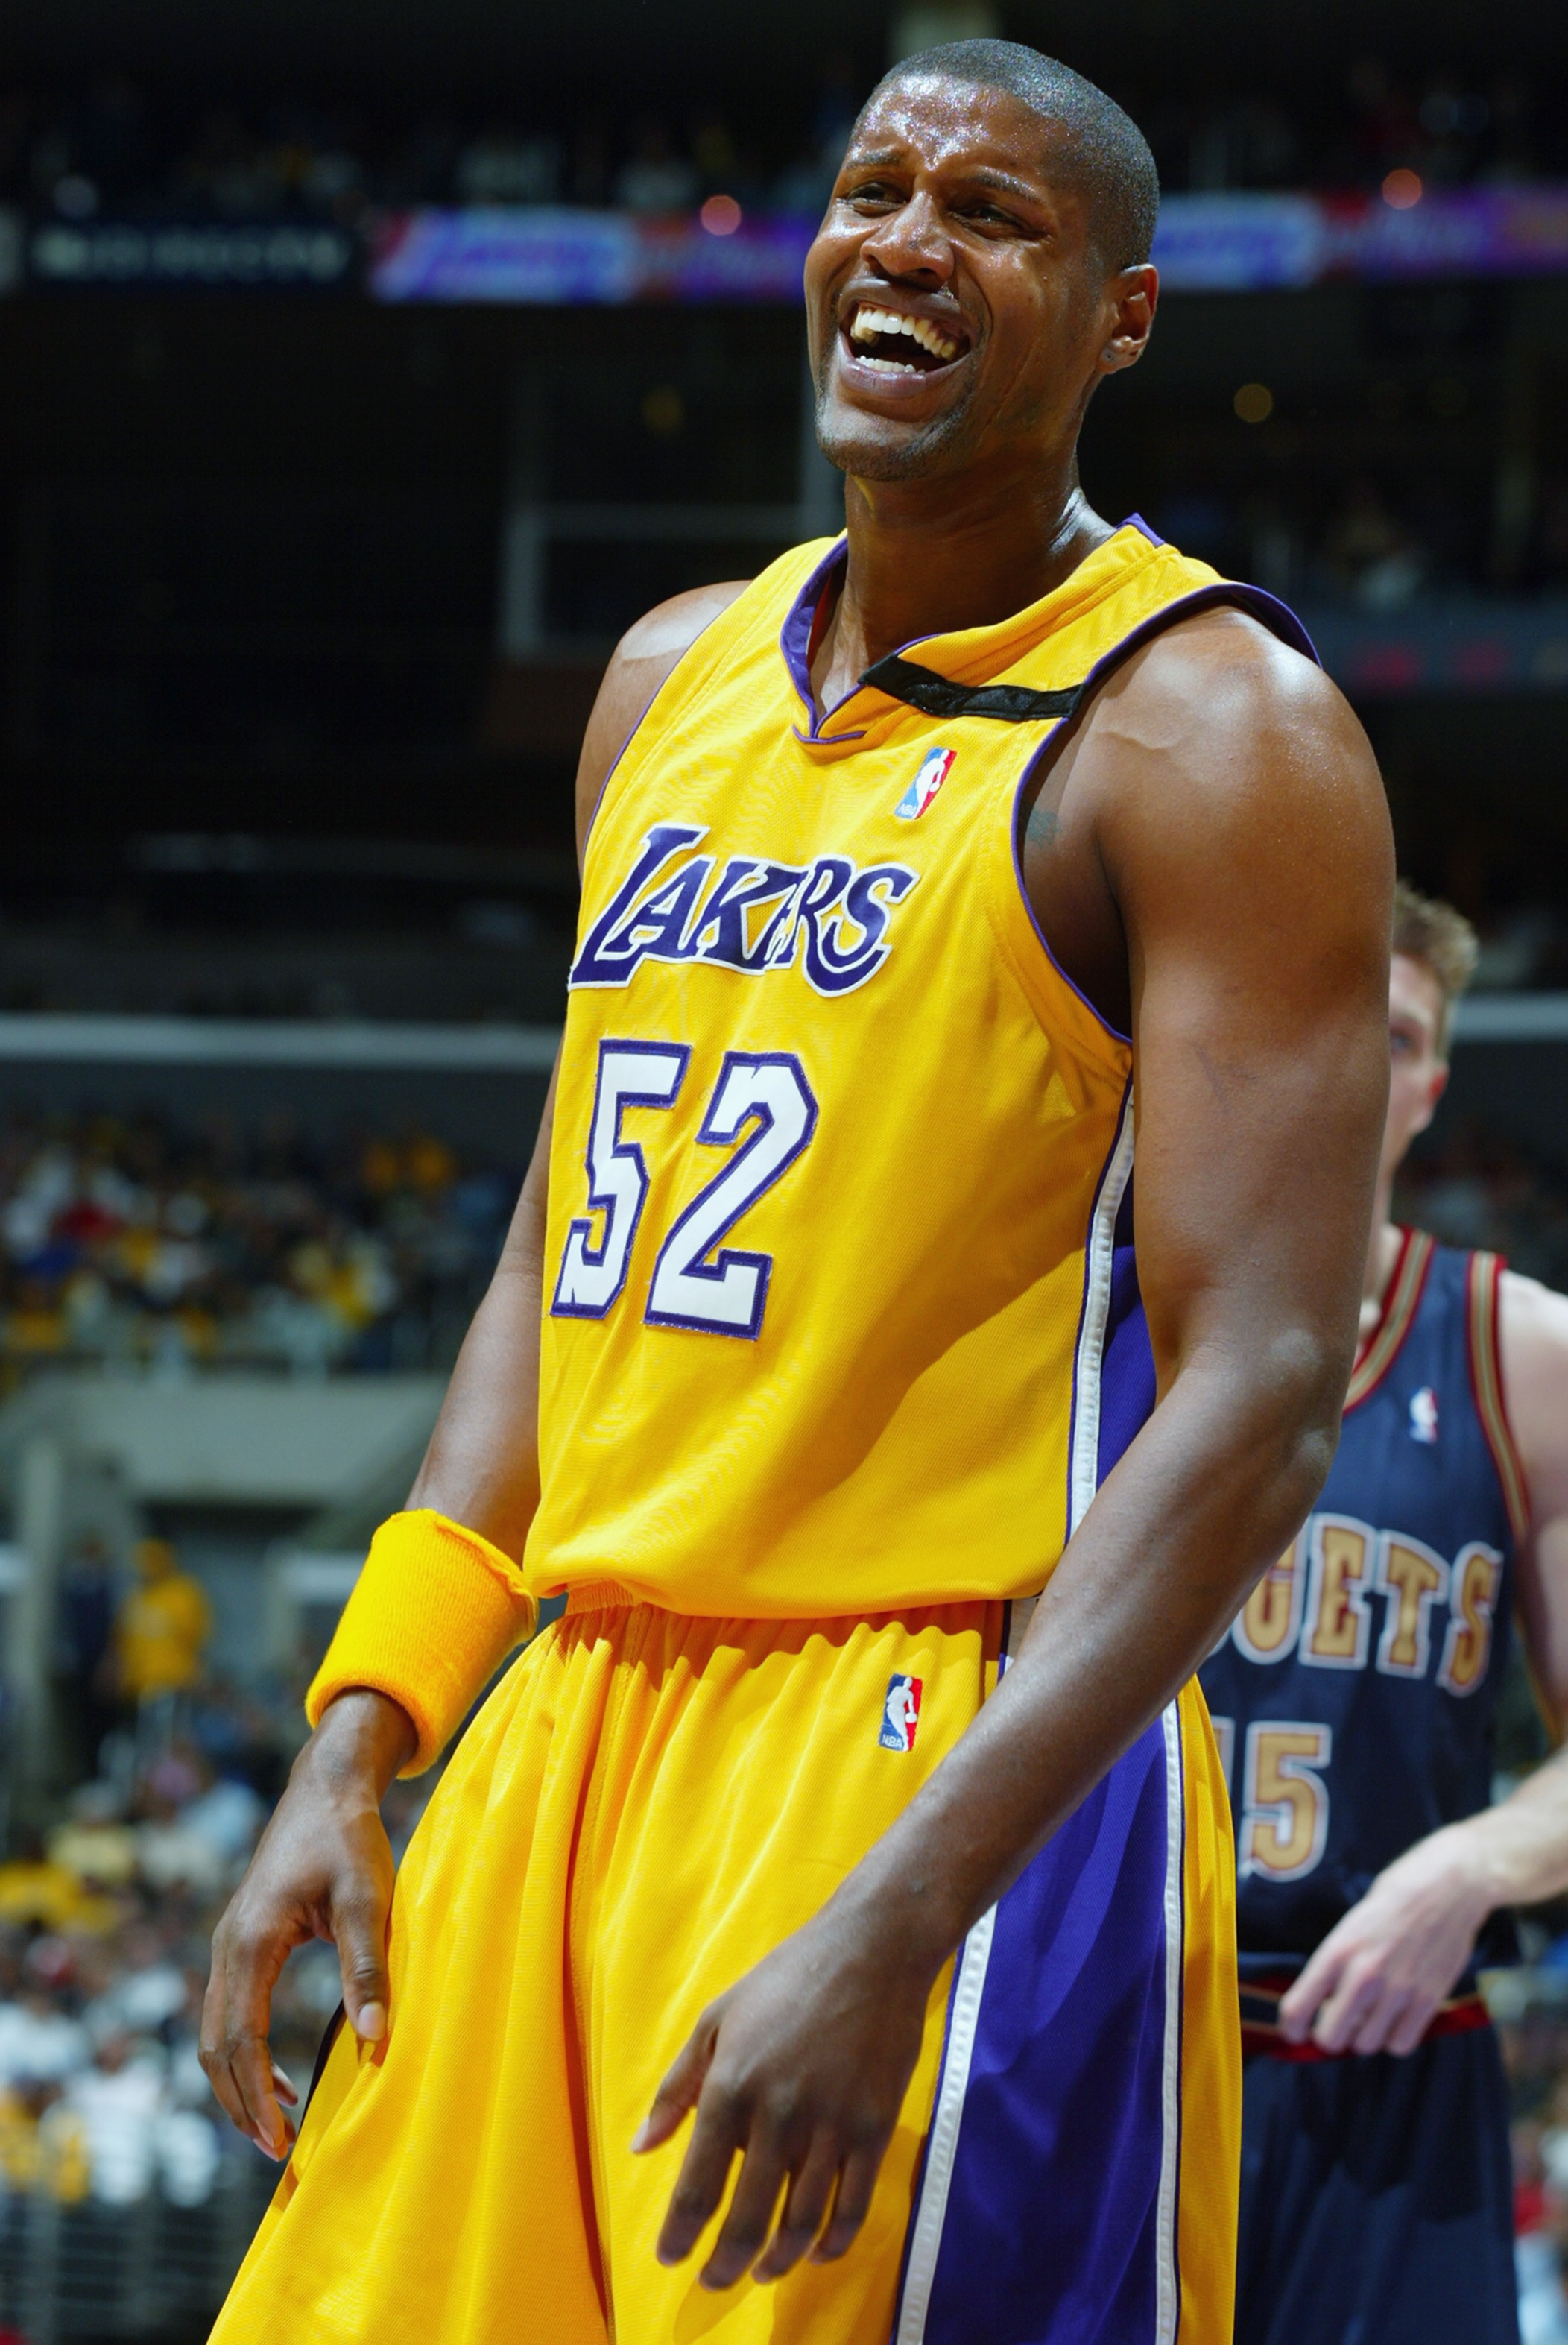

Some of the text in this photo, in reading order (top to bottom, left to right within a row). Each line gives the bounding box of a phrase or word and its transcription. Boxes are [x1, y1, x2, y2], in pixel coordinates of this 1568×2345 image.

[897, 803, 917, 816] NBA
[550, 1038, 818, 1341] 52
[1209, 1512, 1504, 1697] GETS
[882, 1733, 902, 1749] NBA
